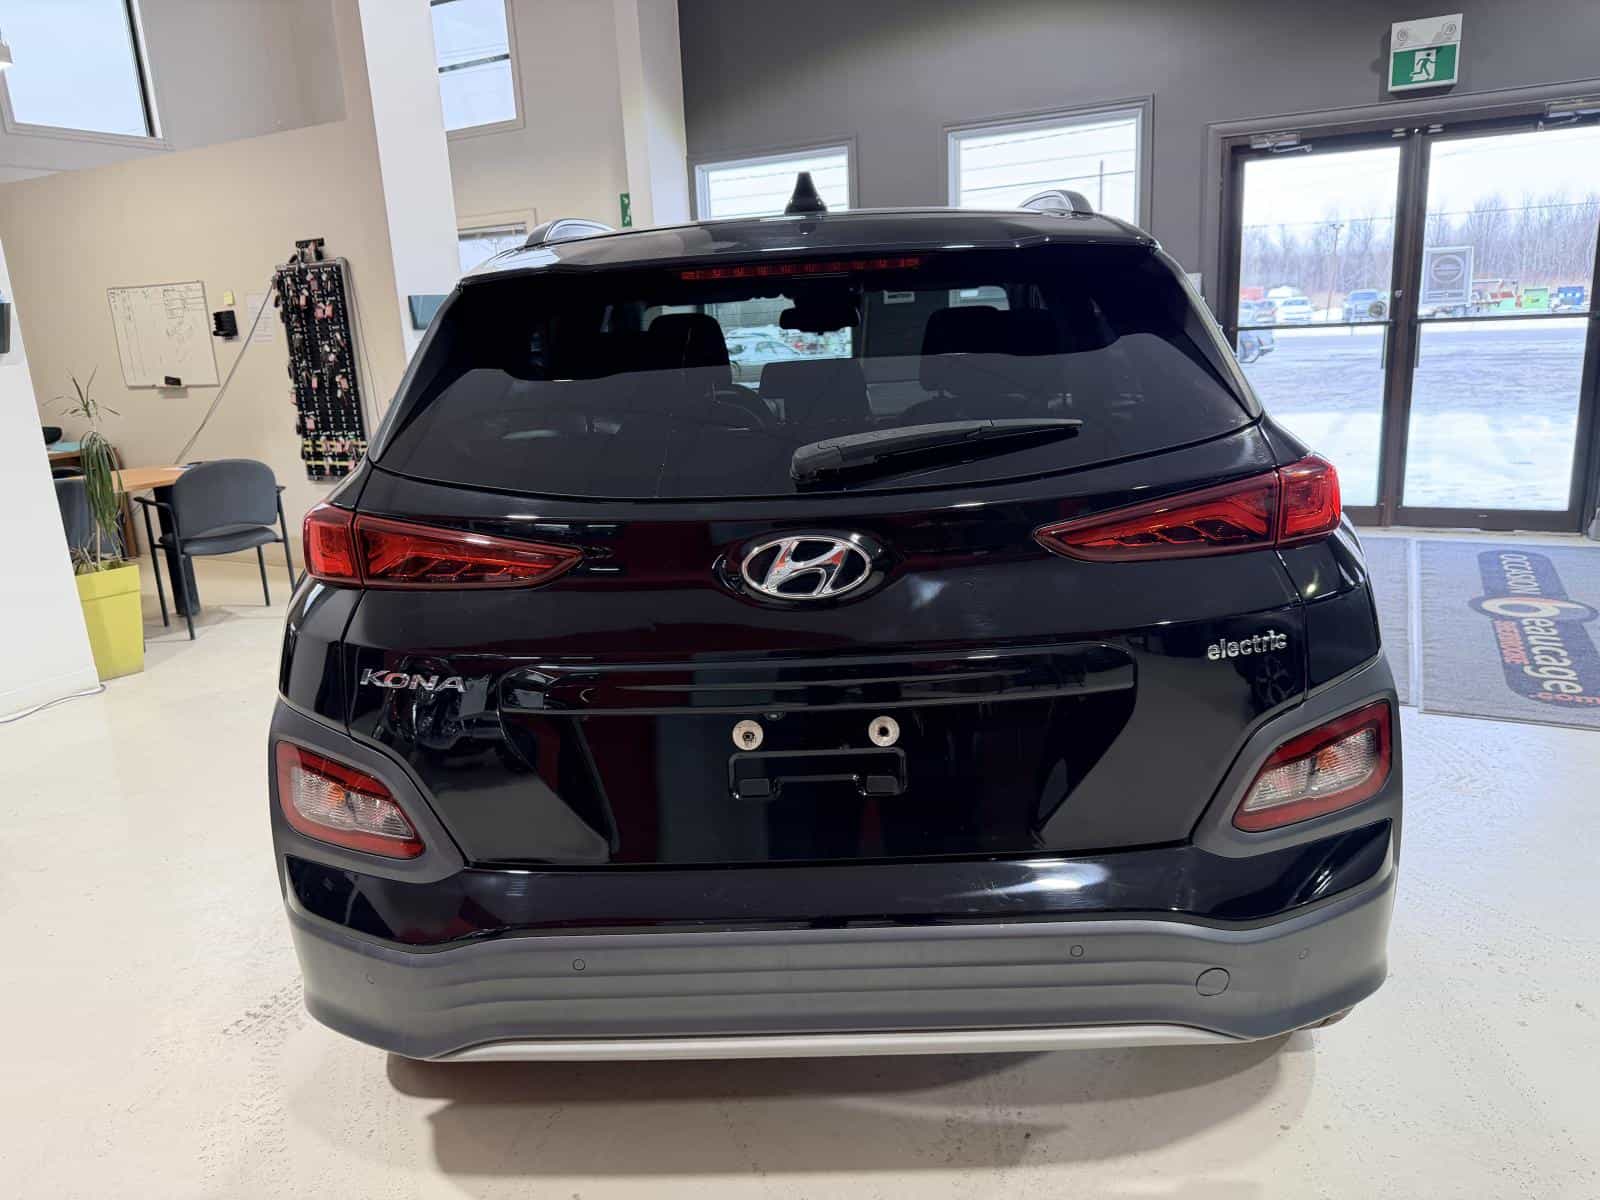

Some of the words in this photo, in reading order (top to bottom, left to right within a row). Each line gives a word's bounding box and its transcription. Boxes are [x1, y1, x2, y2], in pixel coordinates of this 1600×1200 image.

[1500, 553, 1541, 595] OCCASION
[1207, 629, 1288, 660] electric
[359, 667, 467, 693] KONA
